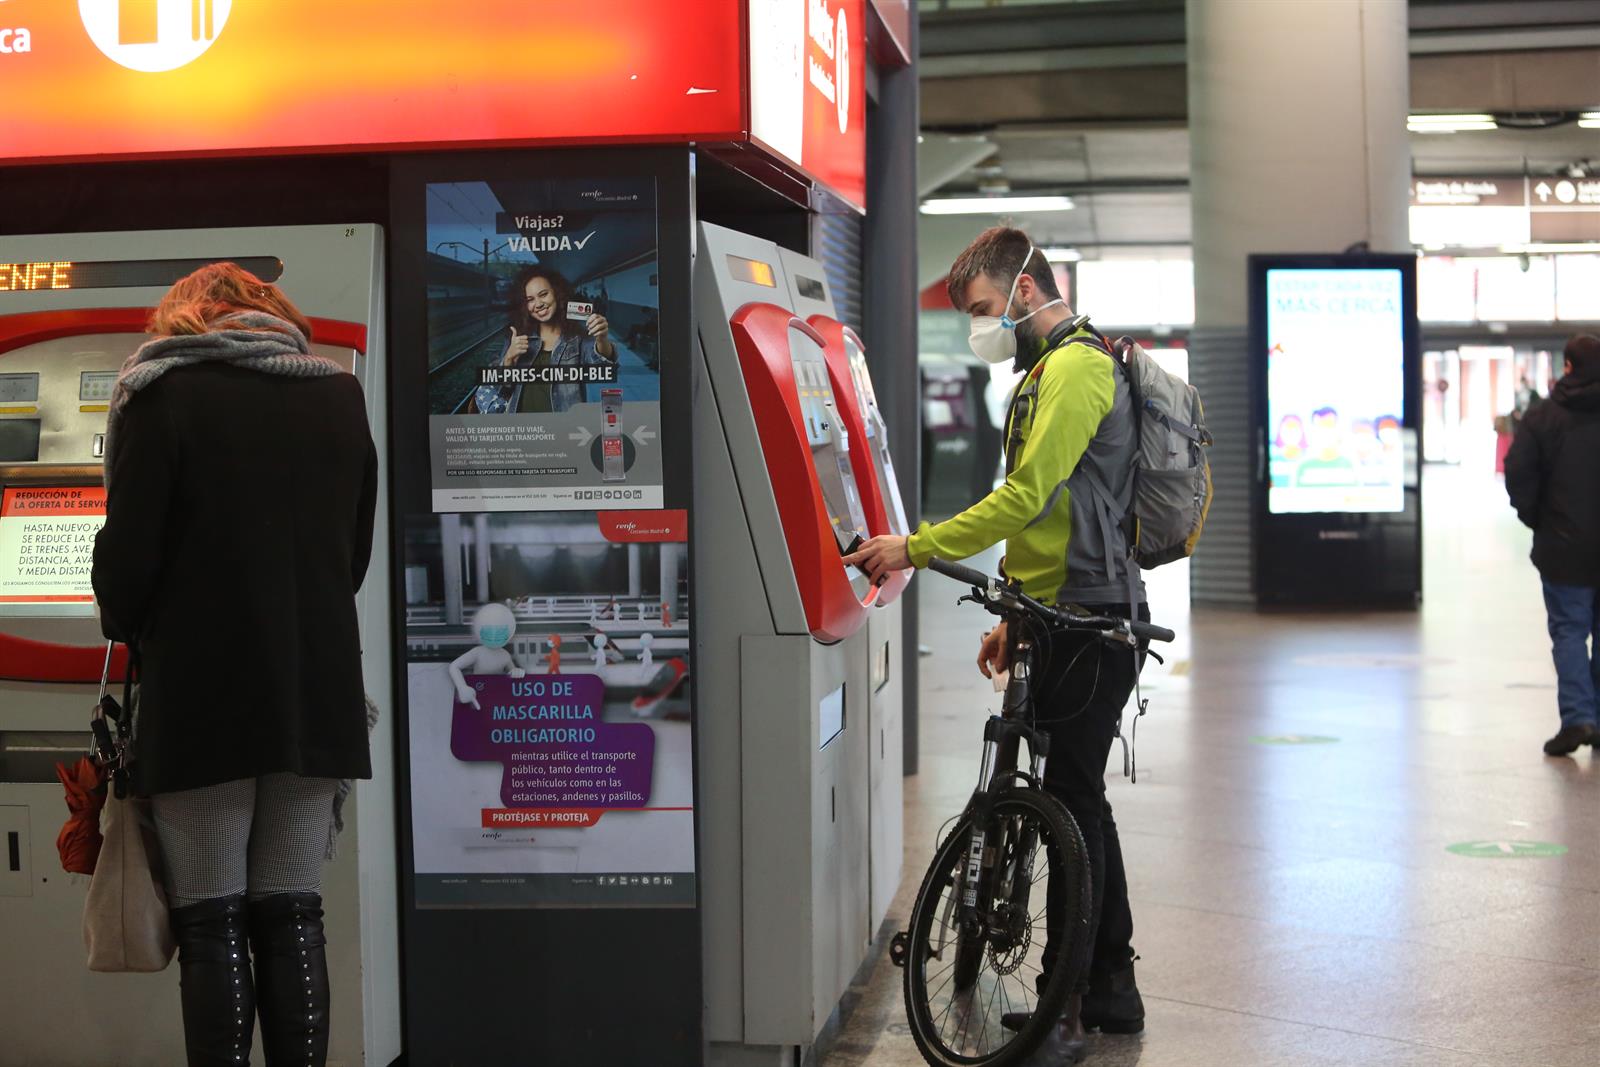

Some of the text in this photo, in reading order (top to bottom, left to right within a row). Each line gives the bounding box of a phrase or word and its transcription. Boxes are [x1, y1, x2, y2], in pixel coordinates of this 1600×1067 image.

[515, 216, 564, 229] Viajas?
[508, 236, 572, 252] VALIDA
[482, 366, 613, 383] IM-PRES-CIN-DI-BLE
[478, 426, 516, 434] EMPRENDER
[526, 426, 546, 434] VIAJE,
[479, 434, 504, 443] TARJETA
[16, 490, 68, 500] REDUCCIÓN
[24, 524, 54, 532] HASTA
[56, 524, 90, 532] NUEVO
[616, 522, 636, 531] renfe
[22, 535, 32, 543] SE
[35, 534, 71, 542] REDUCE
[74, 534, 85, 542] LA
[20, 545, 92, 554] DE TRENES AVE,
[19, 556, 72, 565] DISTANCIA,
[26, 567, 56, 575] MEDIA
[512, 682, 573, 696] USO DE
[492, 704, 593, 720] MASCARILLA
[491, 728, 596, 743] OBLIGATORIO
[512, 751, 636, 762] mientras utilice el transporte
[512, 765, 616, 776] público, tanto dentro de
[512, 778, 622, 788] los vehículos como en las
[512, 792, 644, 803] estaciones, andenes y pasillos.
[492, 812, 589, 823] PROTÉJASE Y PROTEJA
